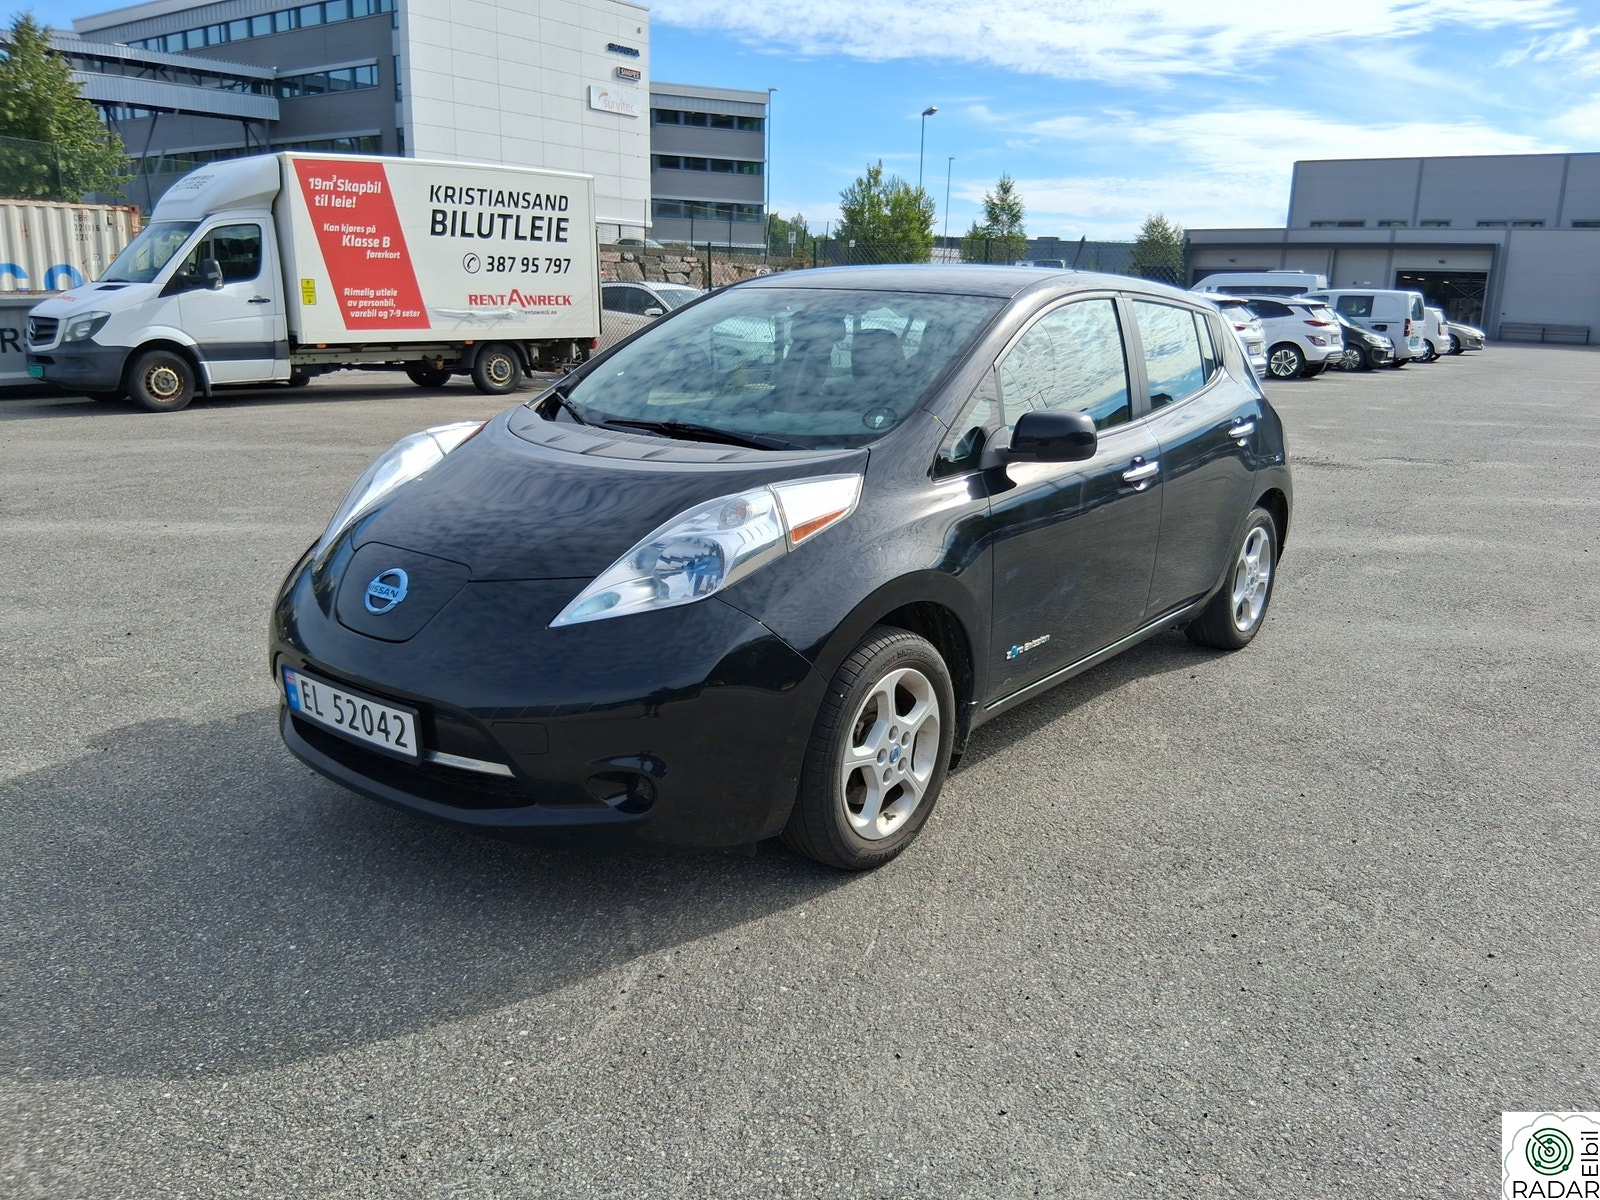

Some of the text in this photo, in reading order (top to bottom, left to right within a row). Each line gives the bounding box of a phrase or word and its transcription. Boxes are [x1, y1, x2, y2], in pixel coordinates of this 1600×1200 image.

[337, 179, 382, 196] Skapbil
[314, 194, 357, 208] til leie!
[429, 184, 569, 212] KRISTIANSAND
[323, 223, 377, 235] Kan kjøres på
[430, 208, 570, 243] BILUTLEIE
[342, 235, 391, 248] Klasse B
[366, 249, 401, 260] førerkort
[486, 255, 572, 275] 387 95 797
[344, 287, 398, 298] Rimelig utleie
[358, 298, 396, 308] personbil,
[350, 309, 421, 319] varebil og 7-9 seter
[369, 583, 399, 598] NISSAN
[301, 679, 324, 717] EL
[333, 693, 408, 749] 52042
